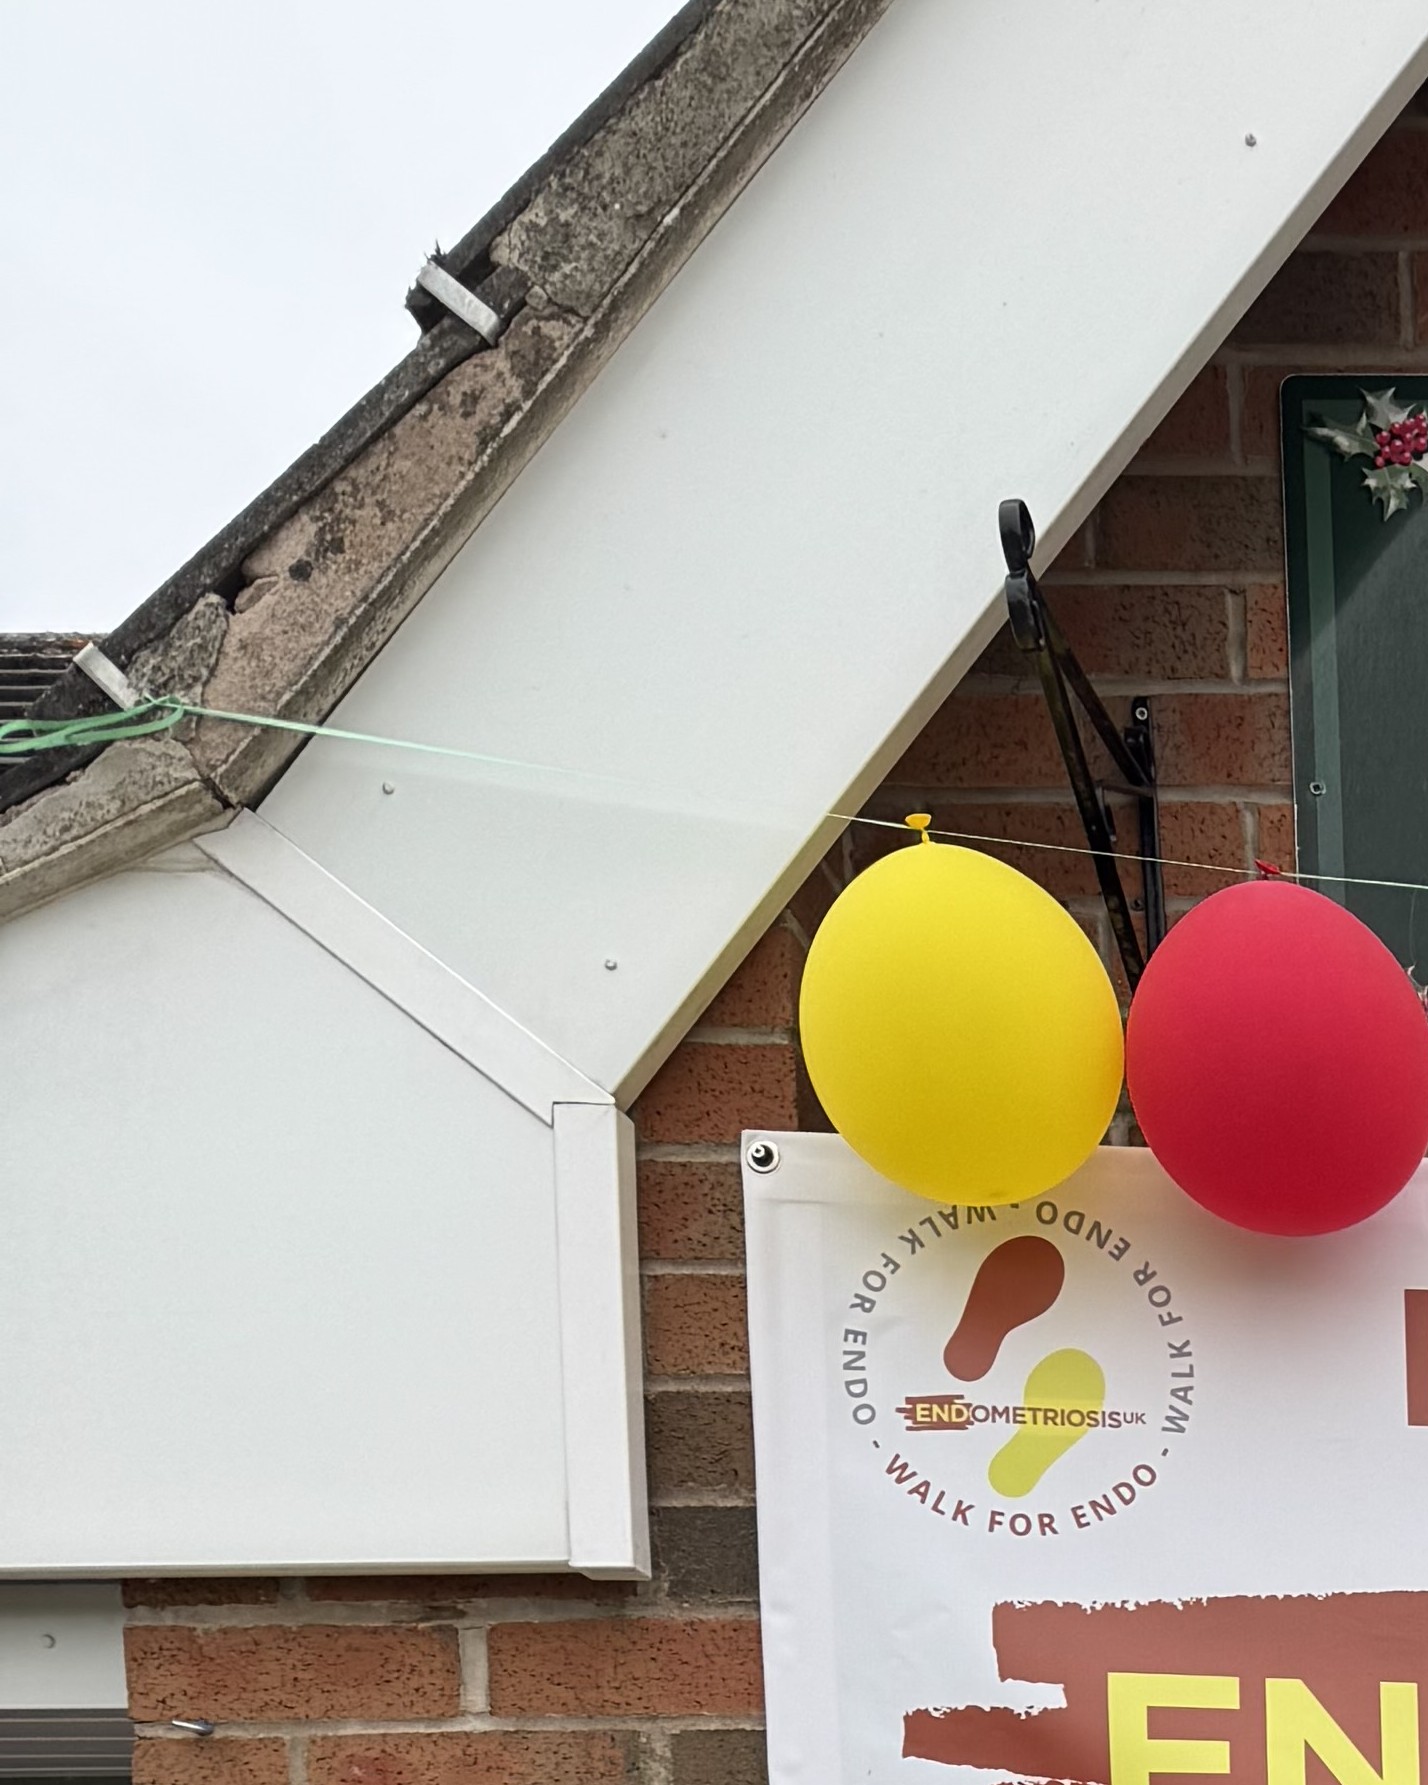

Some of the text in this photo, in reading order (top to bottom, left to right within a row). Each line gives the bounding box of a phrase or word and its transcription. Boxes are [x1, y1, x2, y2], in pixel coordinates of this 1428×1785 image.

[850, 1252, 901, 1314] FOR
[1034, 1200, 1196, 1435] WALK FOR ENDO
[842, 1328, 877, 1426] ENDO
[884, 1453, 1157, 1537] WALK FOR ENDO
